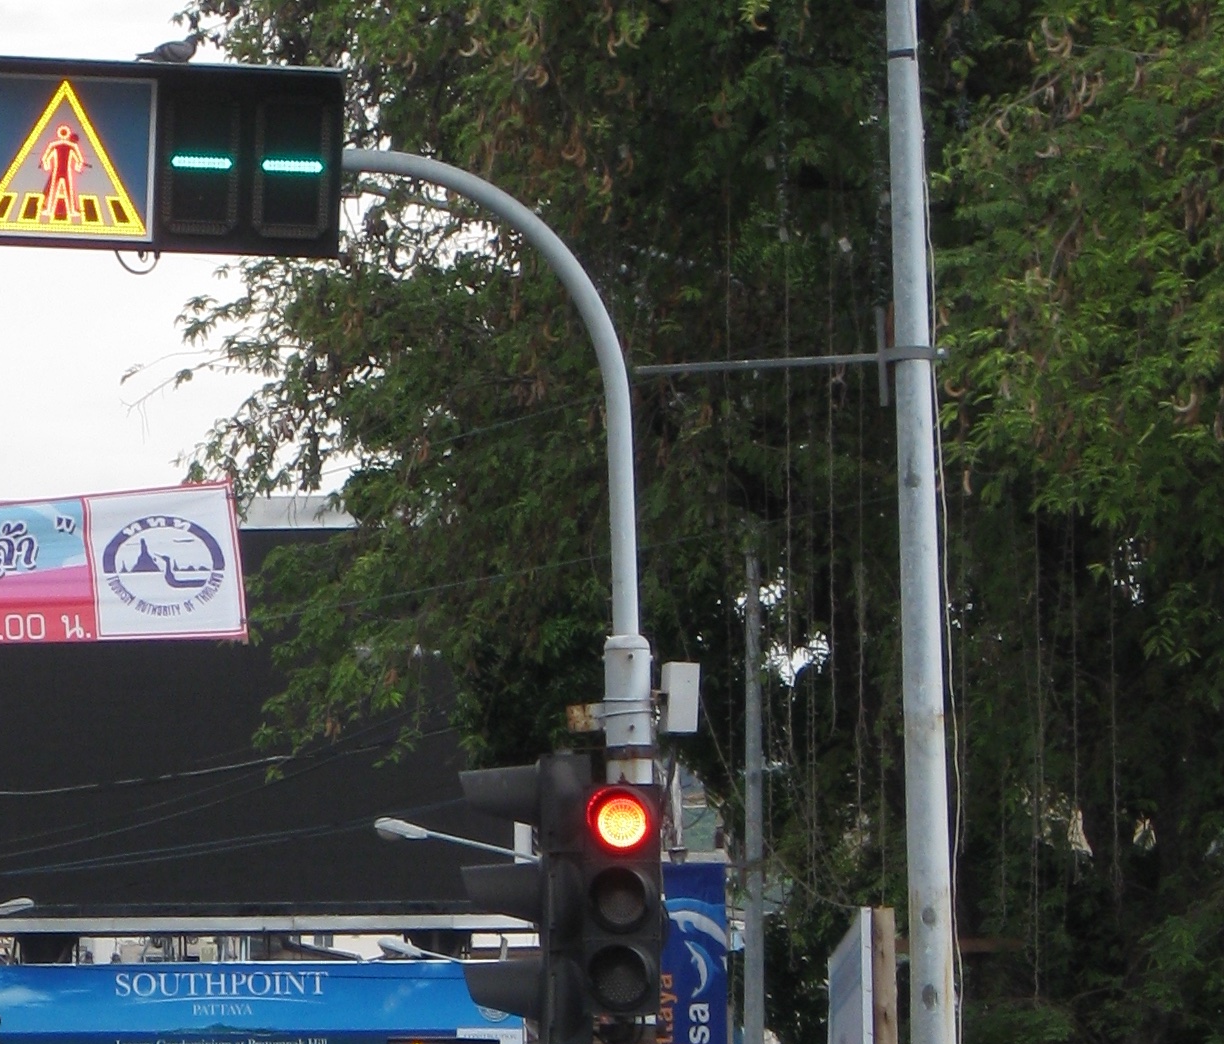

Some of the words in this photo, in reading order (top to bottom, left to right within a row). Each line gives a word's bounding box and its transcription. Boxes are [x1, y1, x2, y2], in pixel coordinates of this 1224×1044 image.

[135, 599, 181, 617] AUTHORITY
[183, 599, 196, 613] OF
[61, 611, 93, 640] น.
[115, 970, 330, 998] SOUTHPOINT
[192, 1003, 253, 1016] PATTAYA
